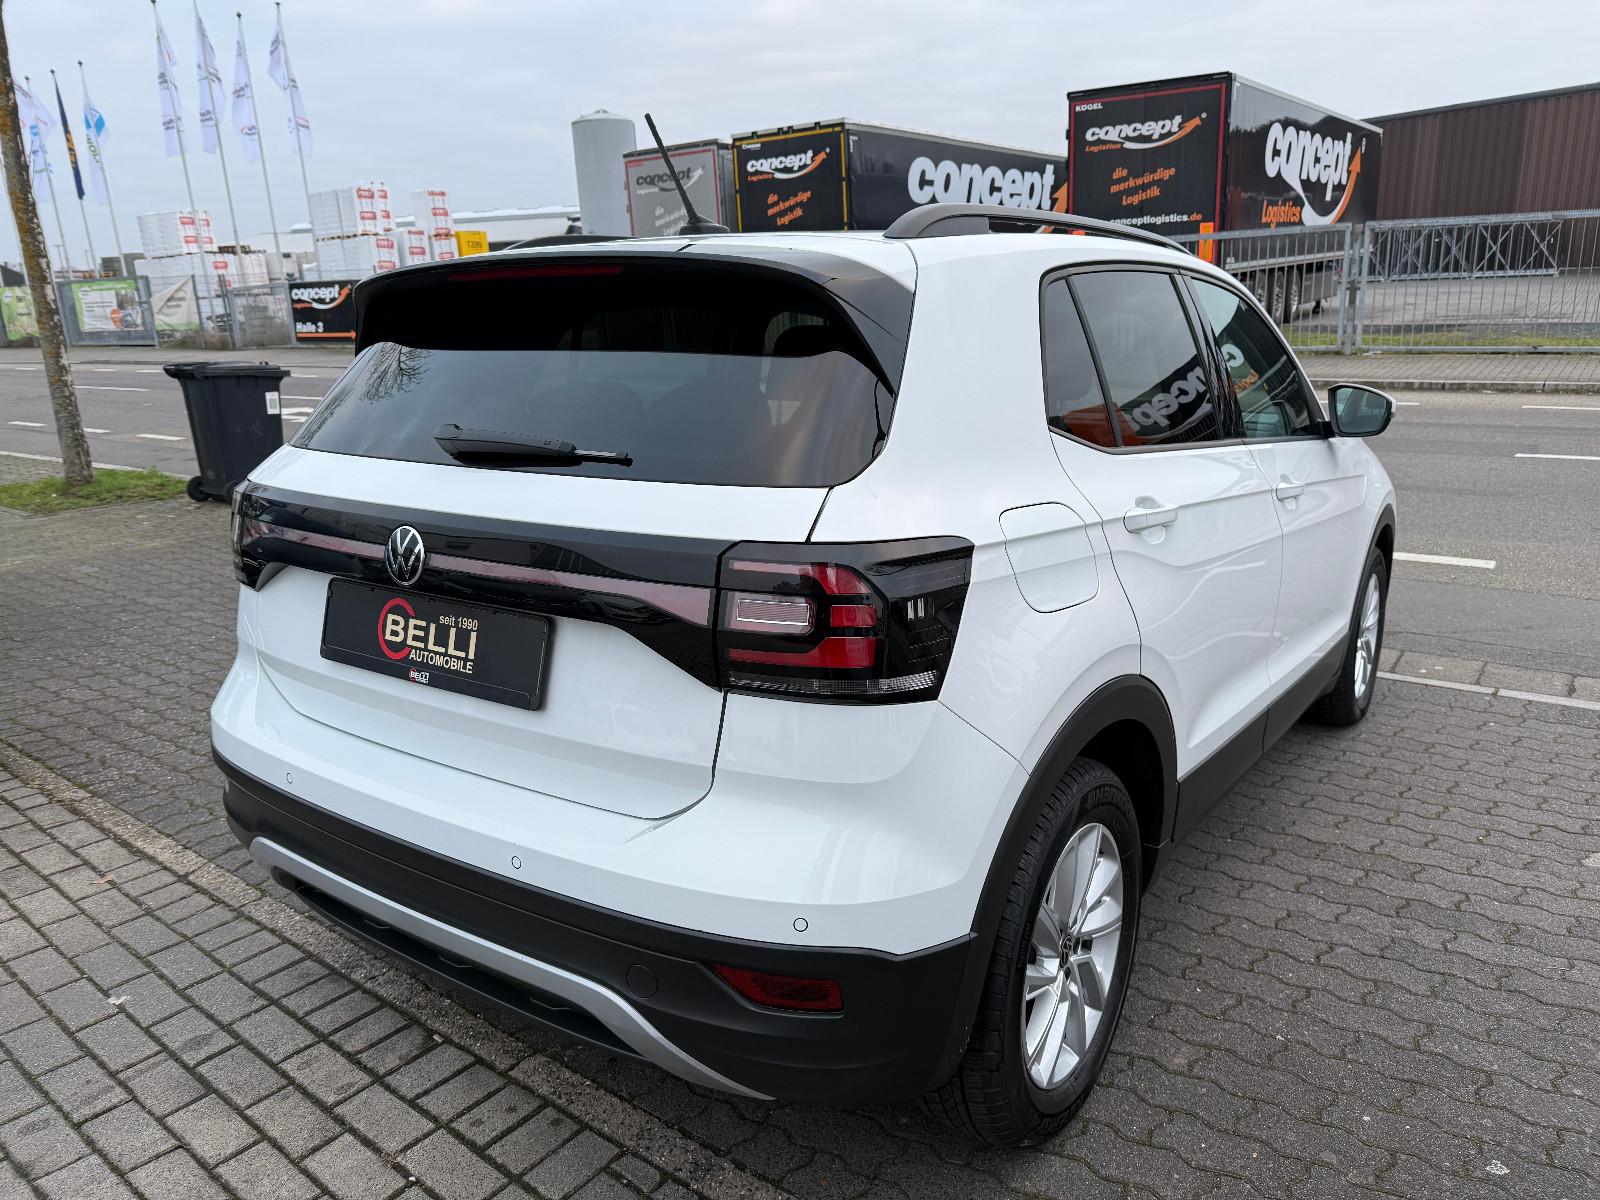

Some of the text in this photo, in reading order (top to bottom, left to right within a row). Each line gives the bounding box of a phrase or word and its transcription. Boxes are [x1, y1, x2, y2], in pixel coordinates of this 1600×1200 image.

[1085, 115, 1182, 141] concept
[1085, 143, 1121, 153] Logistics
[747, 149, 814, 172] concept
[1265, 122, 1352, 201] concept
[908, 156, 1056, 211] concept
[1110, 167, 1176, 194] merkwürdige
[1112, 167, 1128, 180] die
[1122, 186, 1161, 206] Logistik
[1262, 200, 1301, 231] Logistics
[291, 285, 340, 302] concept
[296, 322, 324, 332] Halle 3
[440, 615, 478, 631] seit 1990
[385, 613, 477, 660] BELLI
[409, 649, 474, 674] AUTOMOBILE
